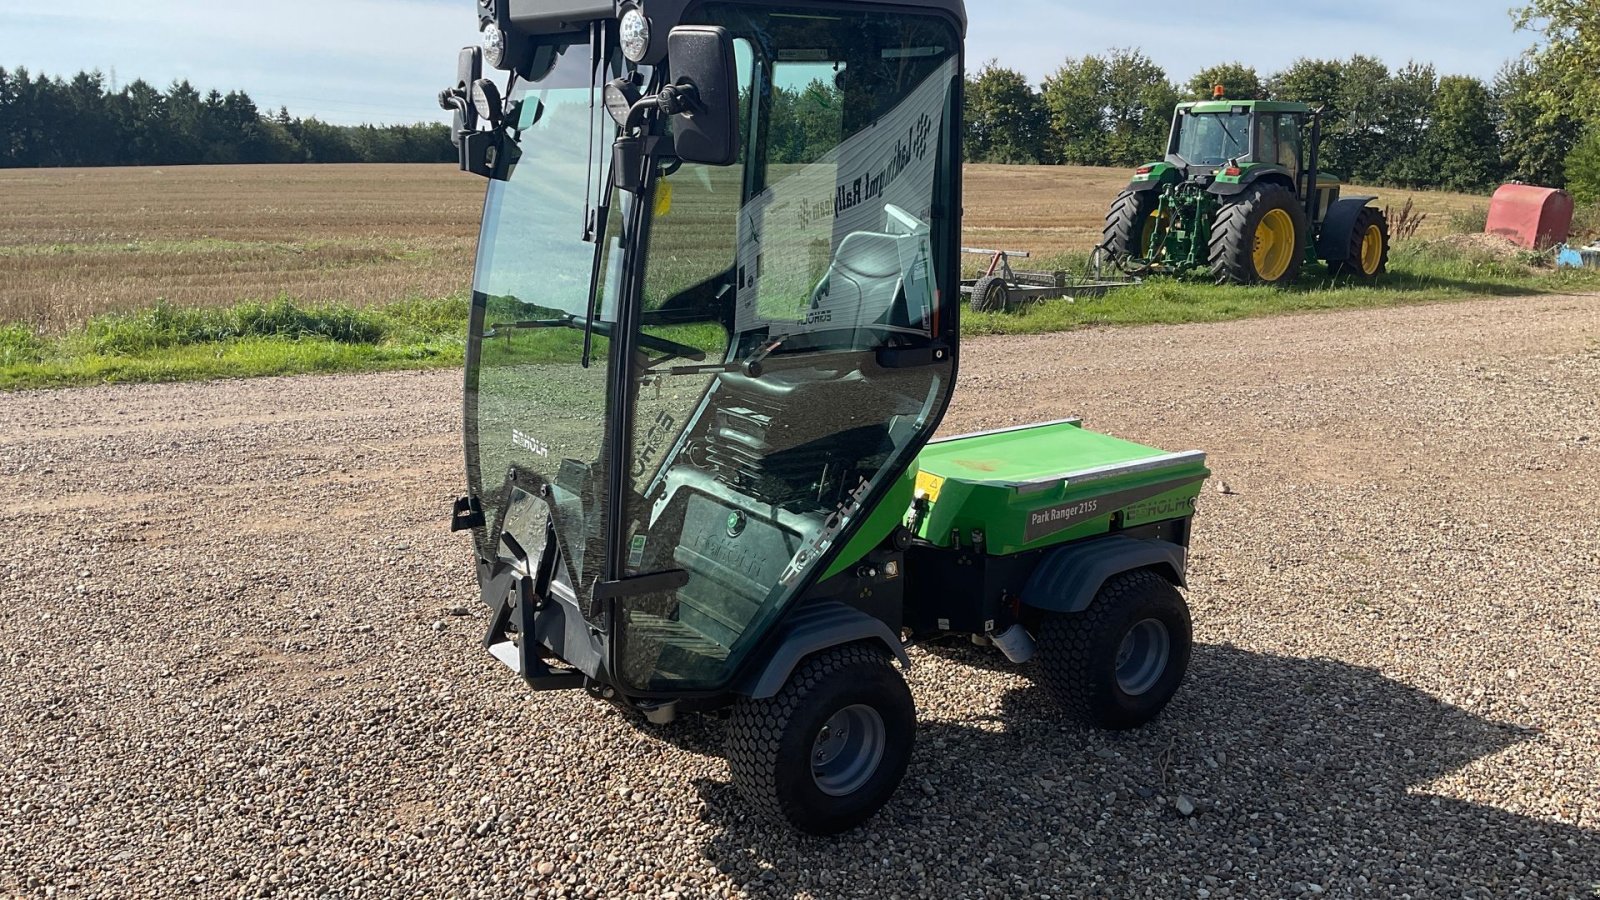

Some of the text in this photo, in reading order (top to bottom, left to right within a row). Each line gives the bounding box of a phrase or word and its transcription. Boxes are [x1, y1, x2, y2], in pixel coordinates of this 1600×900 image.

[512, 428, 548, 459] EGHOLM
[1031, 499, 1098, 525] Park Ranger 2155
[1126, 496, 1187, 521] EGHOLM
